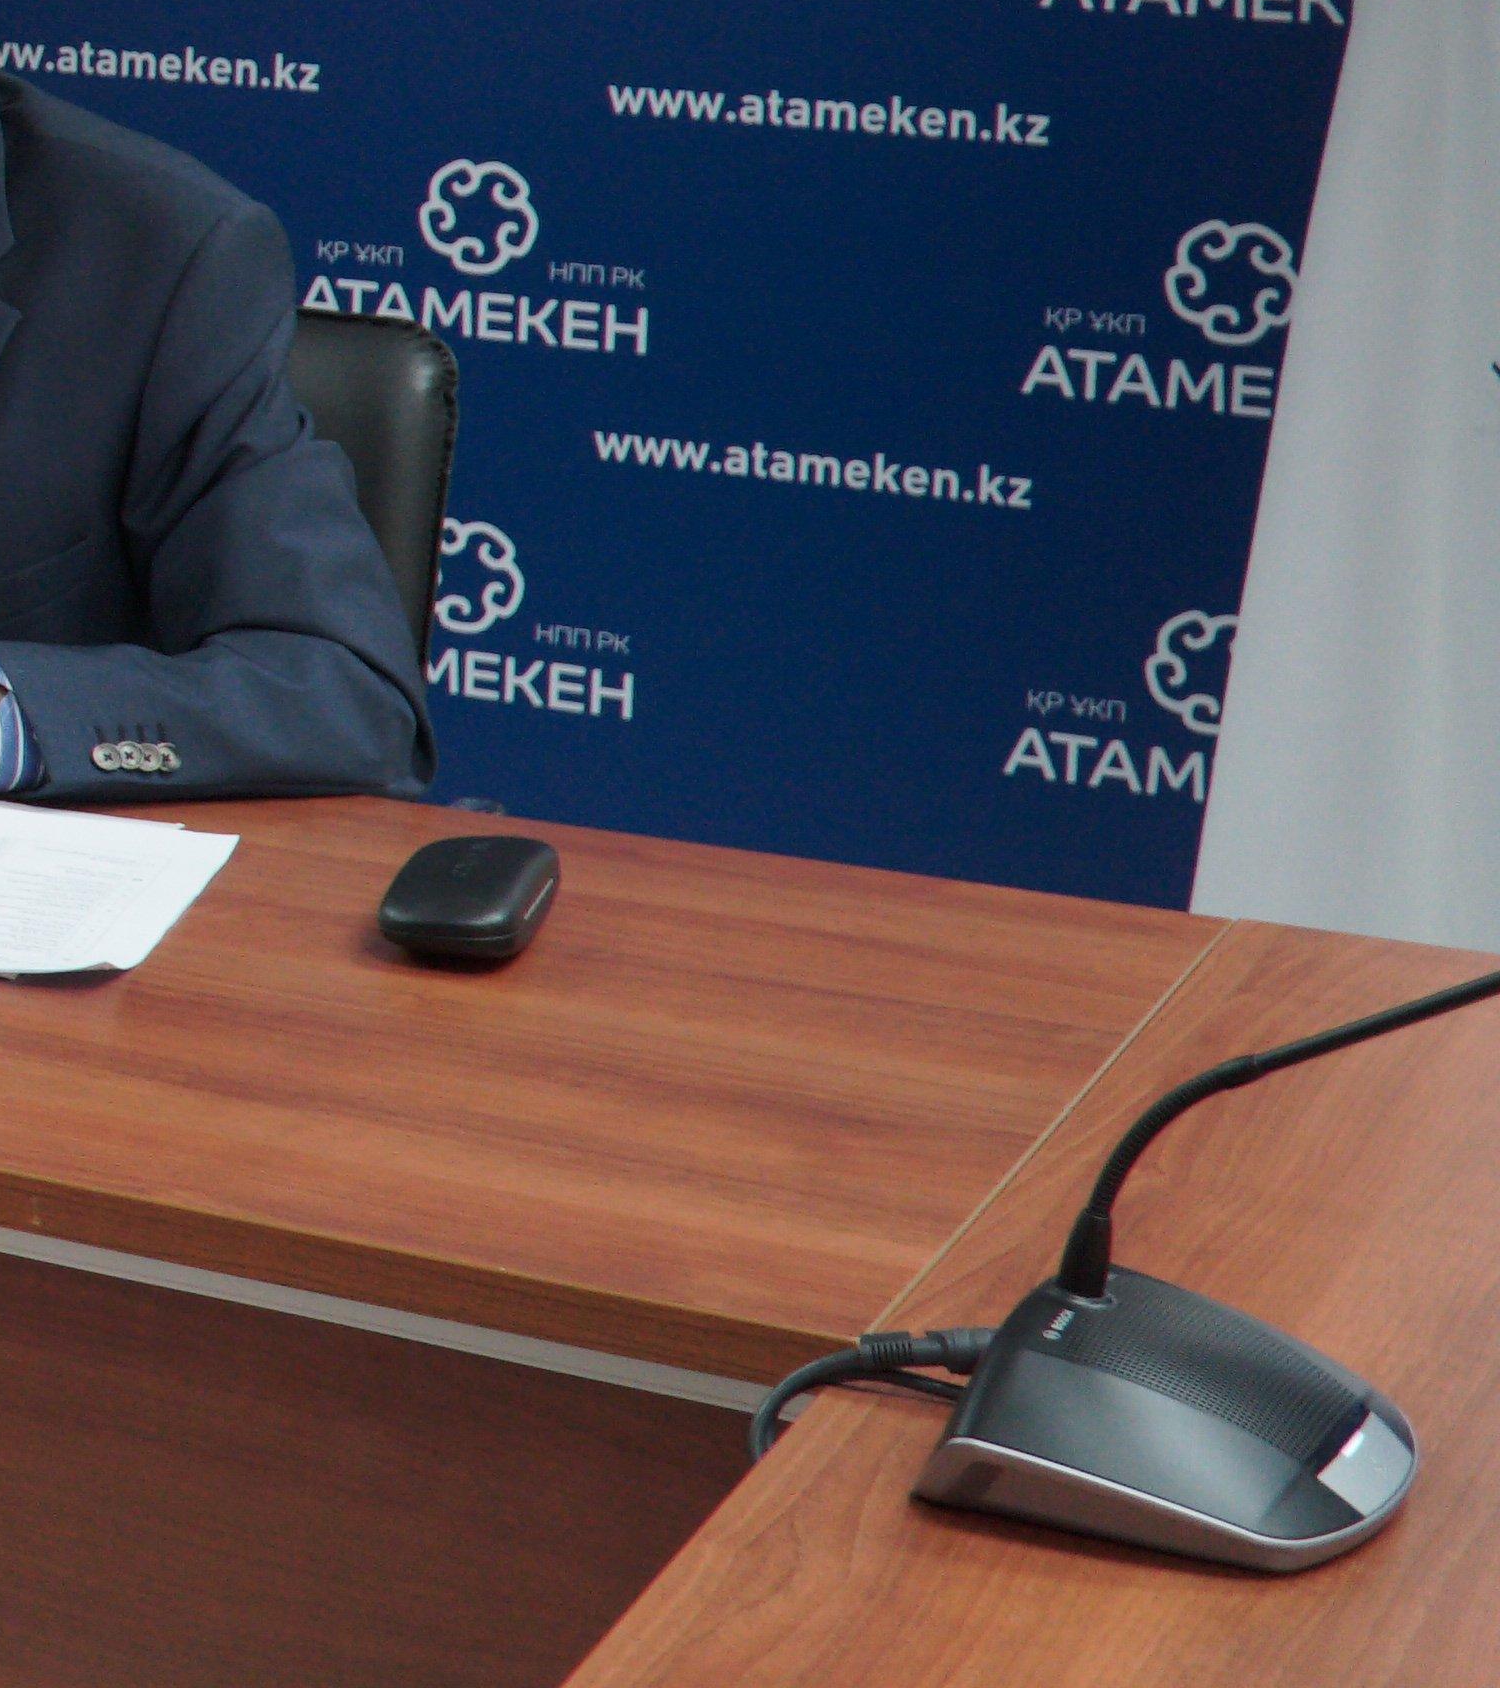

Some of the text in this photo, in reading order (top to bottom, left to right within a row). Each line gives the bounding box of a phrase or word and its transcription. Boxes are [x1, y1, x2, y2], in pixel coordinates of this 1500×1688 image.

[607, 84, 1050, 146] www.atameken.kz
[548, 261, 645, 289] НПП РК
[301, 274, 650, 356] АТАМЕКЕН
[593, 430, 1032, 509] www.atameken.kz
[533, 623, 630, 655] НПП РК
